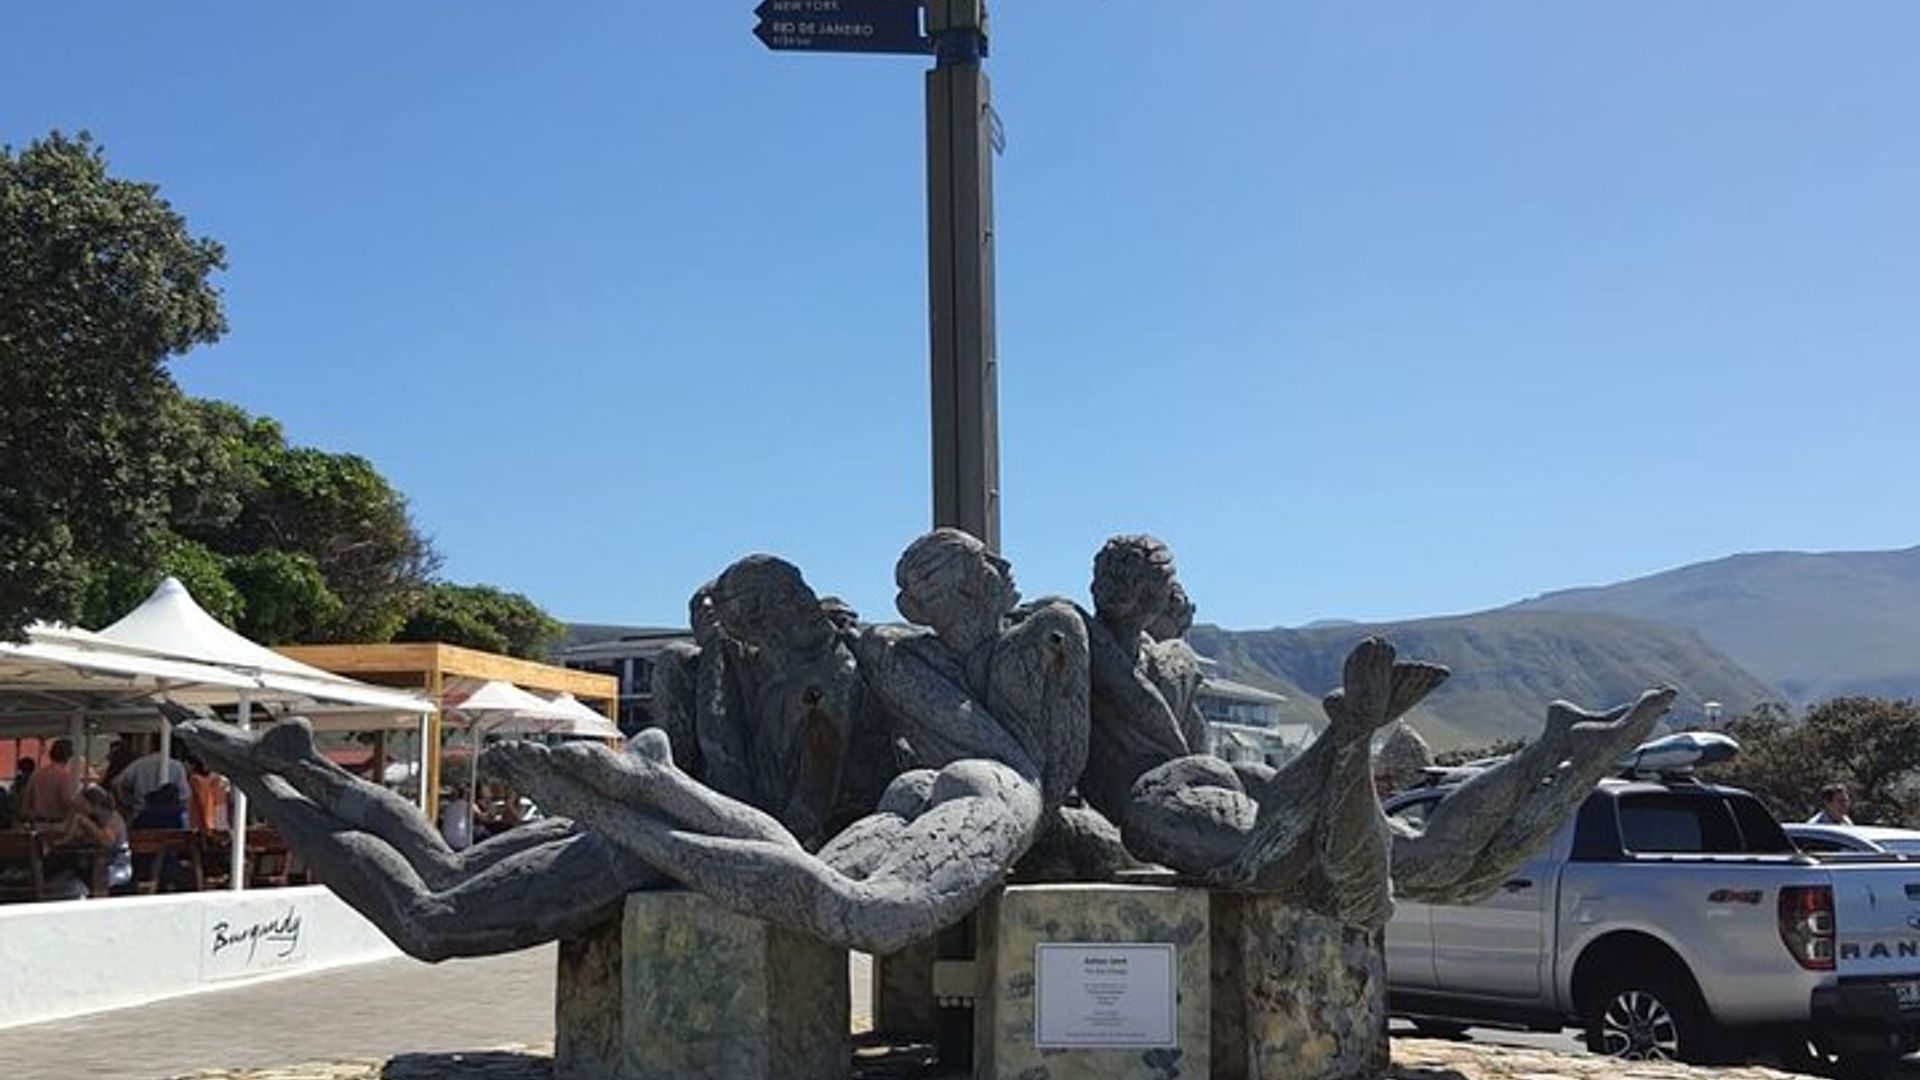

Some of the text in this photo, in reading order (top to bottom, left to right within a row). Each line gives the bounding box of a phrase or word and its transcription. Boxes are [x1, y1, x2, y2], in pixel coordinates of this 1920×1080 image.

[773, 0, 842, 12] NEW YORK
[772, 21, 796, 34] RIO
[798, 22, 816, 35] DE
[213, 905, 302, 967] Burgundy
